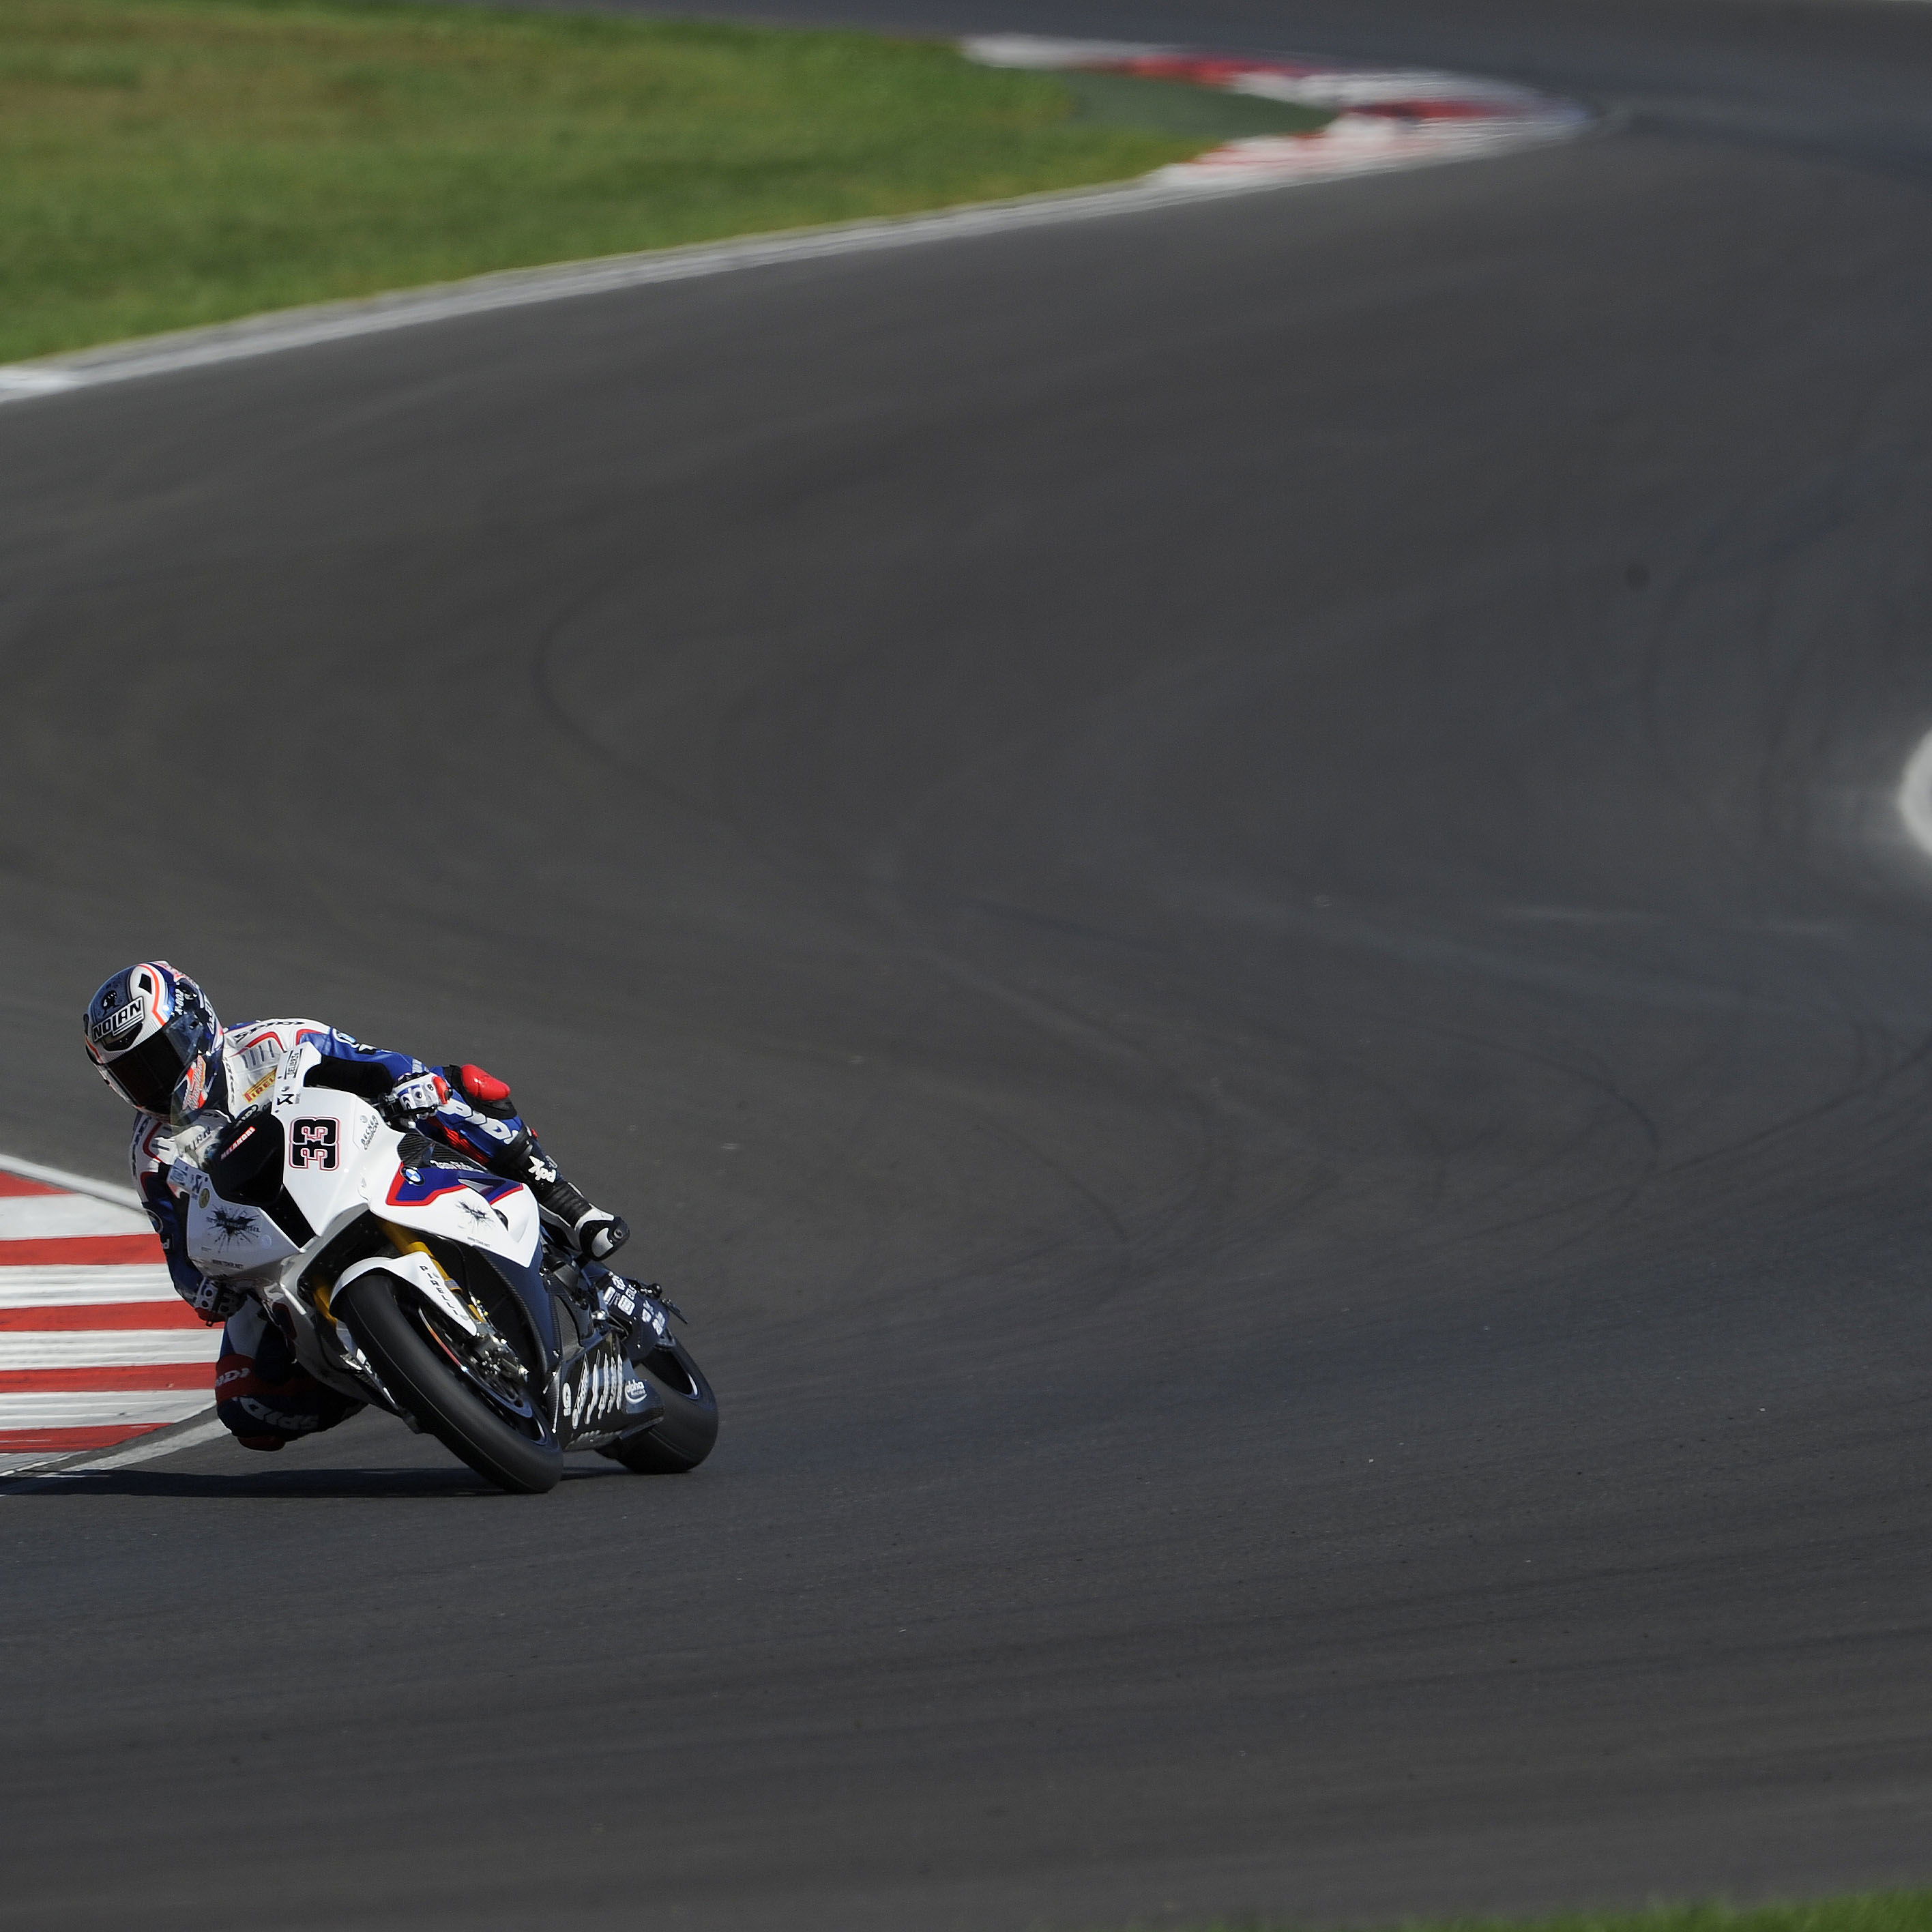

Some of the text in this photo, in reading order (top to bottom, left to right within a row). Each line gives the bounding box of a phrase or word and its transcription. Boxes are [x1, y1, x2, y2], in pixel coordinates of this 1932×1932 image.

[92, 997, 144, 1042] NOLAN
[244, 1068, 277, 1102] PIREL
[289, 1117, 341, 1171] 33
[437, 1097, 519, 1145] PIDI
[419, 1265, 459, 1316] PIRELLI
